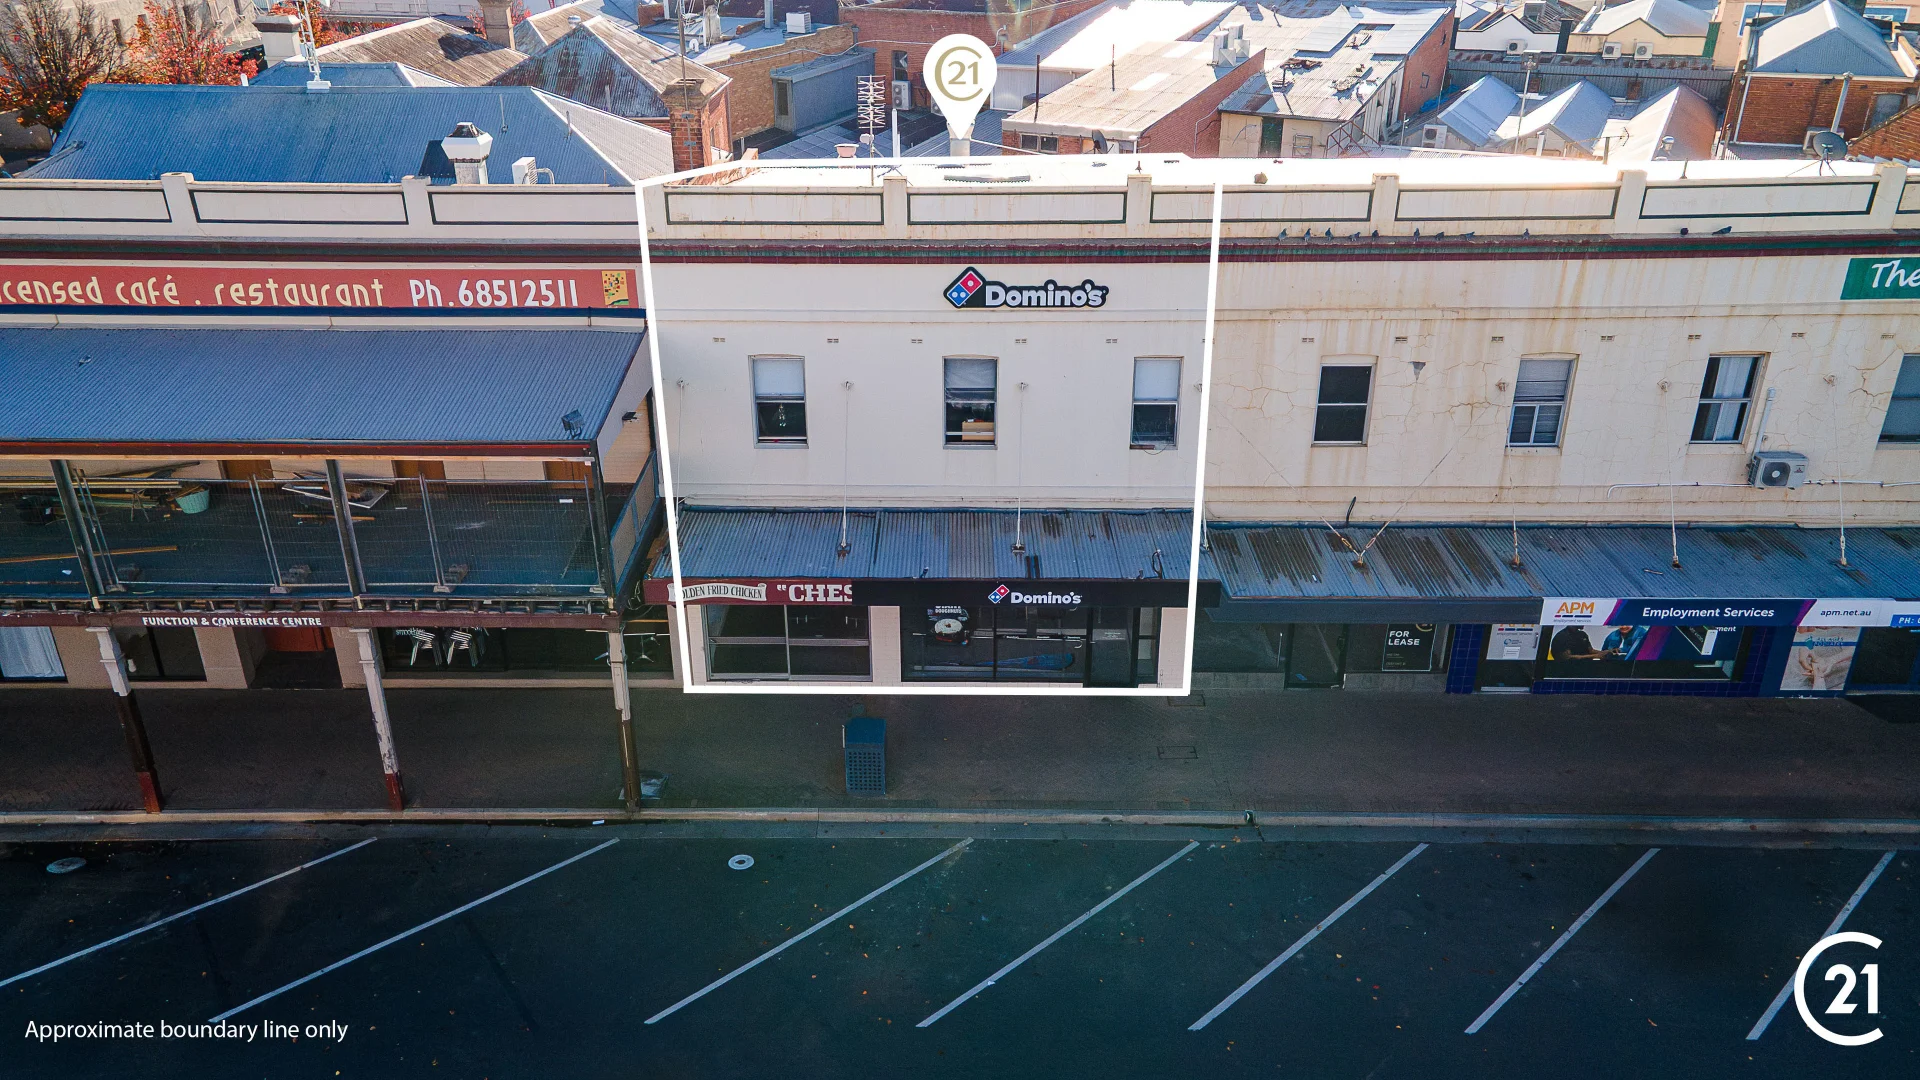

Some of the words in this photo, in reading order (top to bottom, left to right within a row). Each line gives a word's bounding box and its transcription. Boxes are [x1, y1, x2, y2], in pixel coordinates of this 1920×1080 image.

[1871, 259, 1920, 289] The
[0, 276, 104, 304] censed
[115, 274, 180, 305] café
[214, 278, 384, 306] restaurant
[985, 283, 1103, 306] Domino's
[682, 585, 705, 600] OLDEN
[707, 585, 729, 597] FRIED
[731, 585, 763, 600] CHICKEN
[1010, 591, 1082, 604] Domino's
[1556, 601, 1595, 614] APM
[1642, 607, 1720, 619] Employment
[1723, 607, 1775, 618] Services
[1820, 609, 1872, 617] apm.net.au
[142, 617, 198, 626] FUNCTION
[201, 617, 210, 626] &
[212, 617, 279, 626] CONFERENCE
[282, 617, 322, 626] CENTRE
[1389, 630, 1410, 638] FOR
[1388, 638, 1421, 646] LEASE
